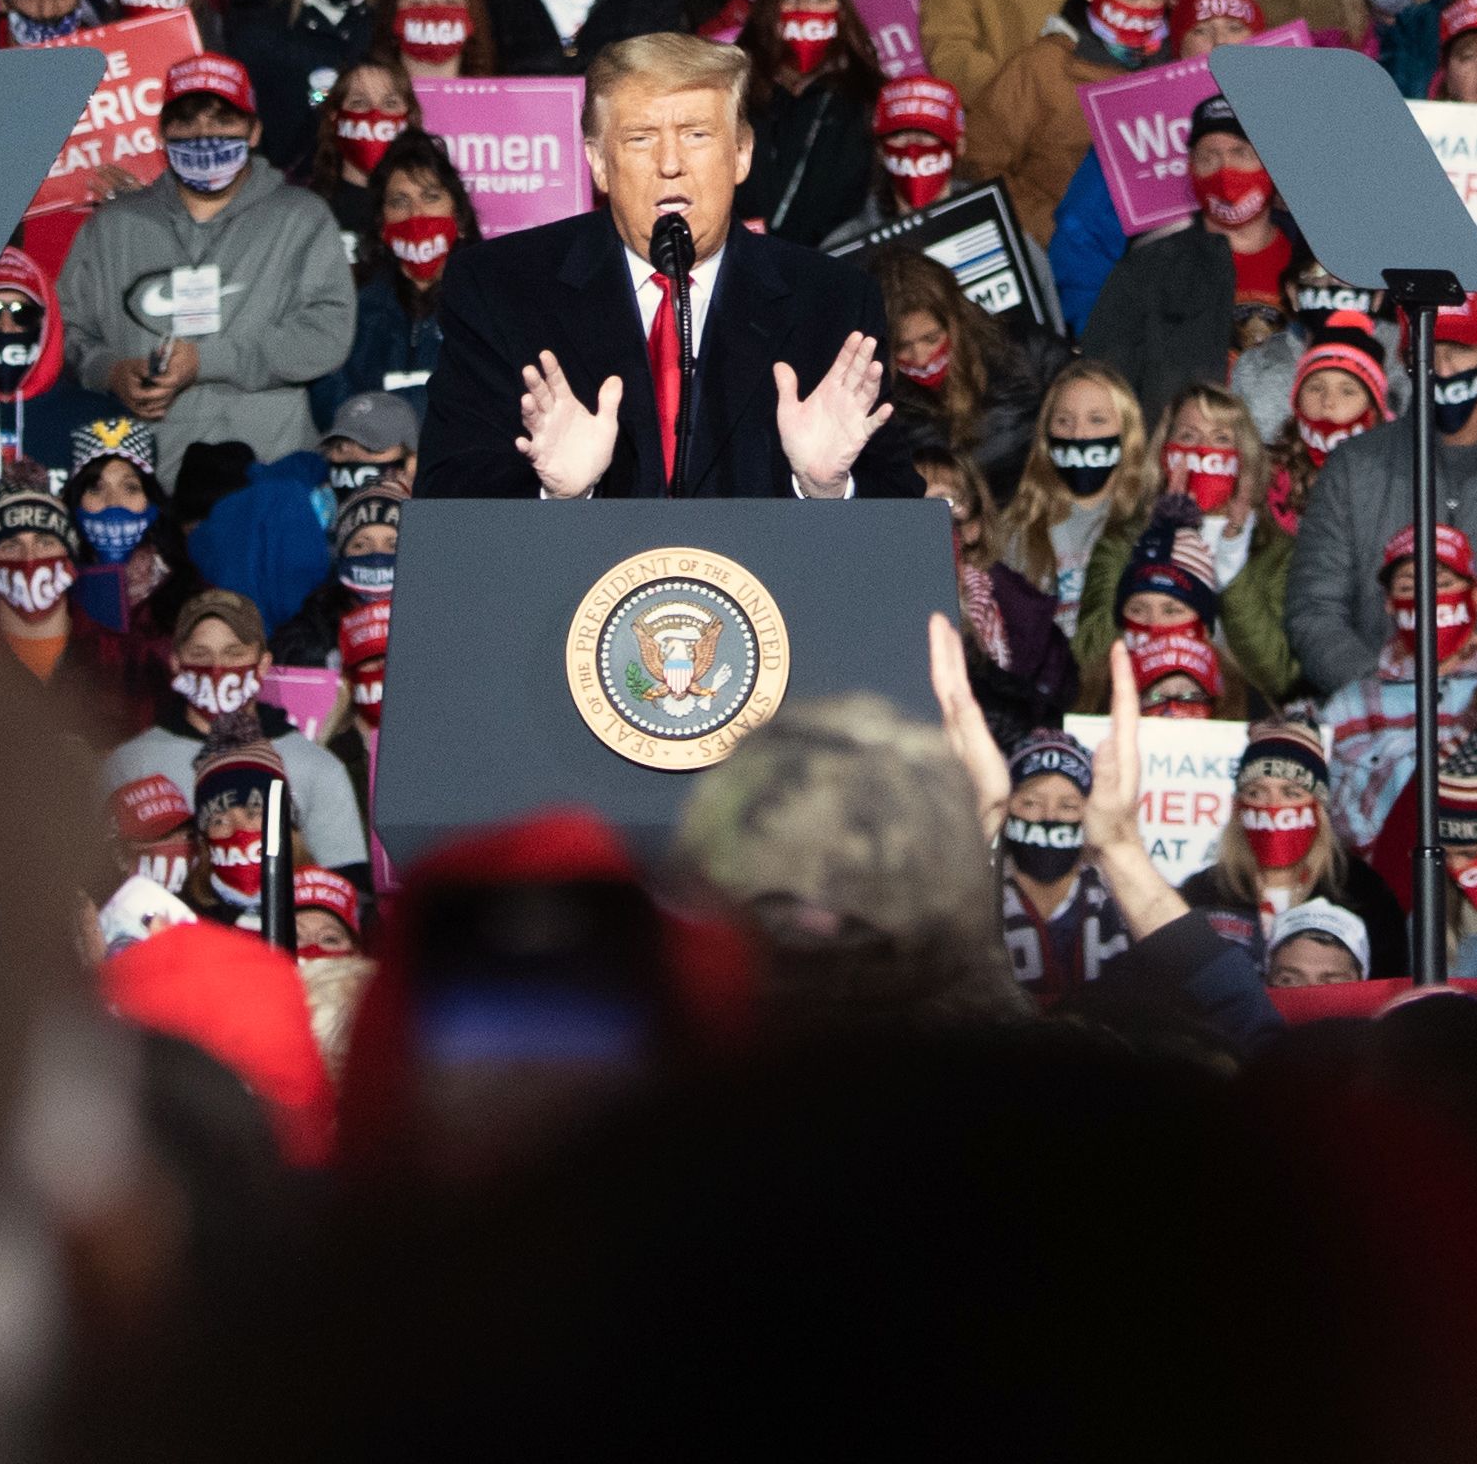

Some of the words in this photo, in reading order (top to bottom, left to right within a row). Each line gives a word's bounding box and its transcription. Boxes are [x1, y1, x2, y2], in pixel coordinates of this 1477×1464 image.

[405, 18, 464, 44] MAGA
[783, 18, 838, 40] AGA
[170, 140, 248, 174] TRUMP
[445, 132, 559, 170] men
[1153, 161, 1188, 179] FO
[392, 233, 449, 264] MAGA
[3, 504, 69, 529] GREAT
[352, 566, 395, 585] TRUM
[679, 559, 699, 572] OF
[702, 561, 732, 583] THE
[575, 557, 672, 653] PRESIDENT
[737, 583, 782, 671] UNITED
[579, 661, 593, 693] THE
[173, 673, 260, 713] MAGA
[588, 694, 604, 714] OF
[601, 714, 658, 758] SEAL
[209, 840, 264, 866] MAG
